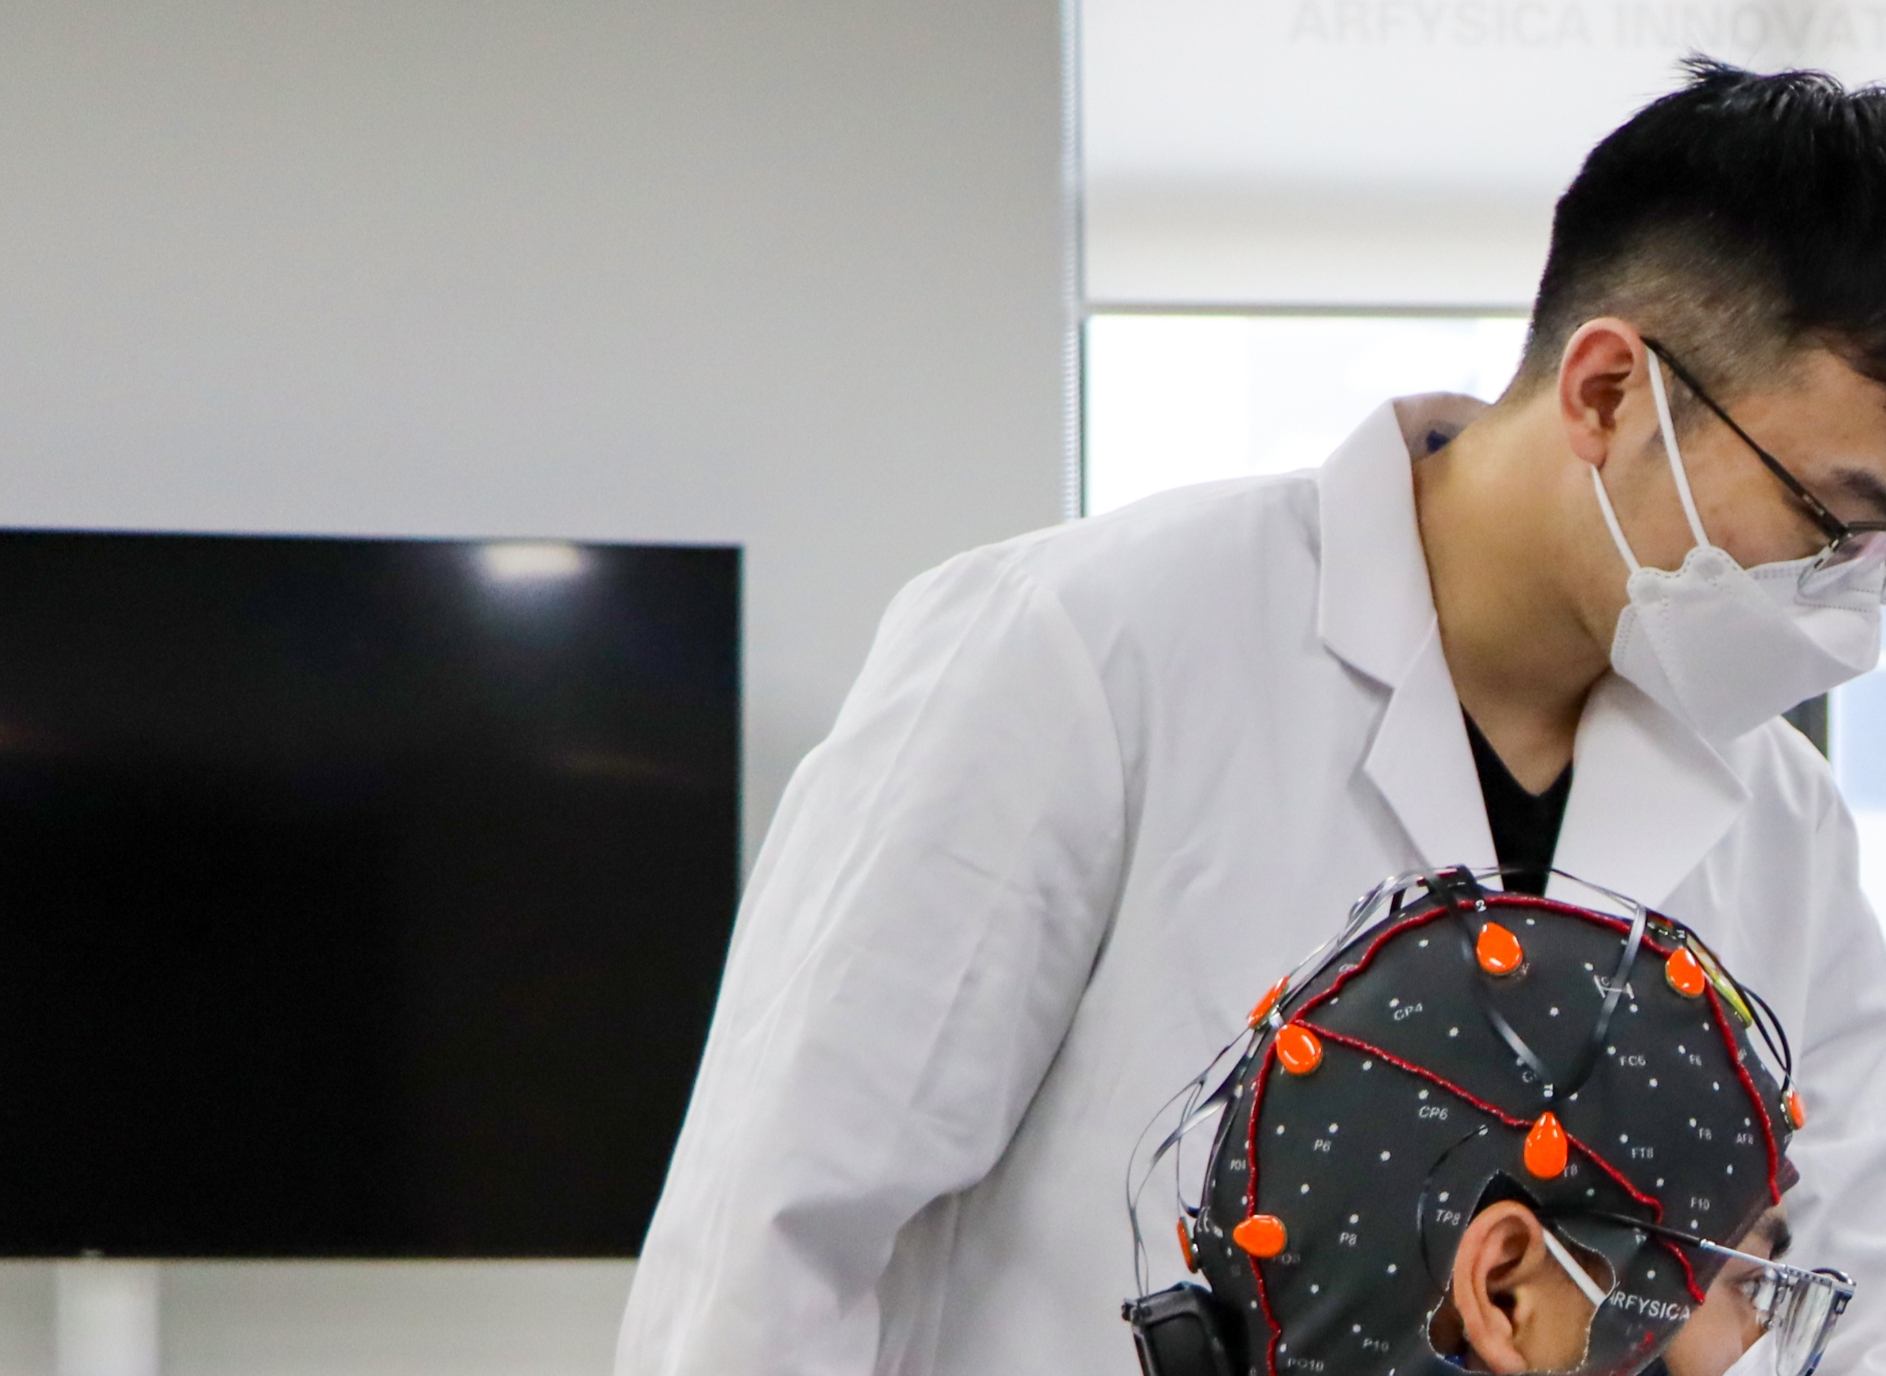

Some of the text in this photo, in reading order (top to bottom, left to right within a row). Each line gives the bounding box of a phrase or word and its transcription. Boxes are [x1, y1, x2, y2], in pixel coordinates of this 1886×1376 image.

[1286, 2, 1594, 49] ARFYSICA
[1620, 1055, 1646, 1067] FC6
[1419, 1106, 1448, 1120] CP6
[1340, 1232, 1357, 1245] P8
